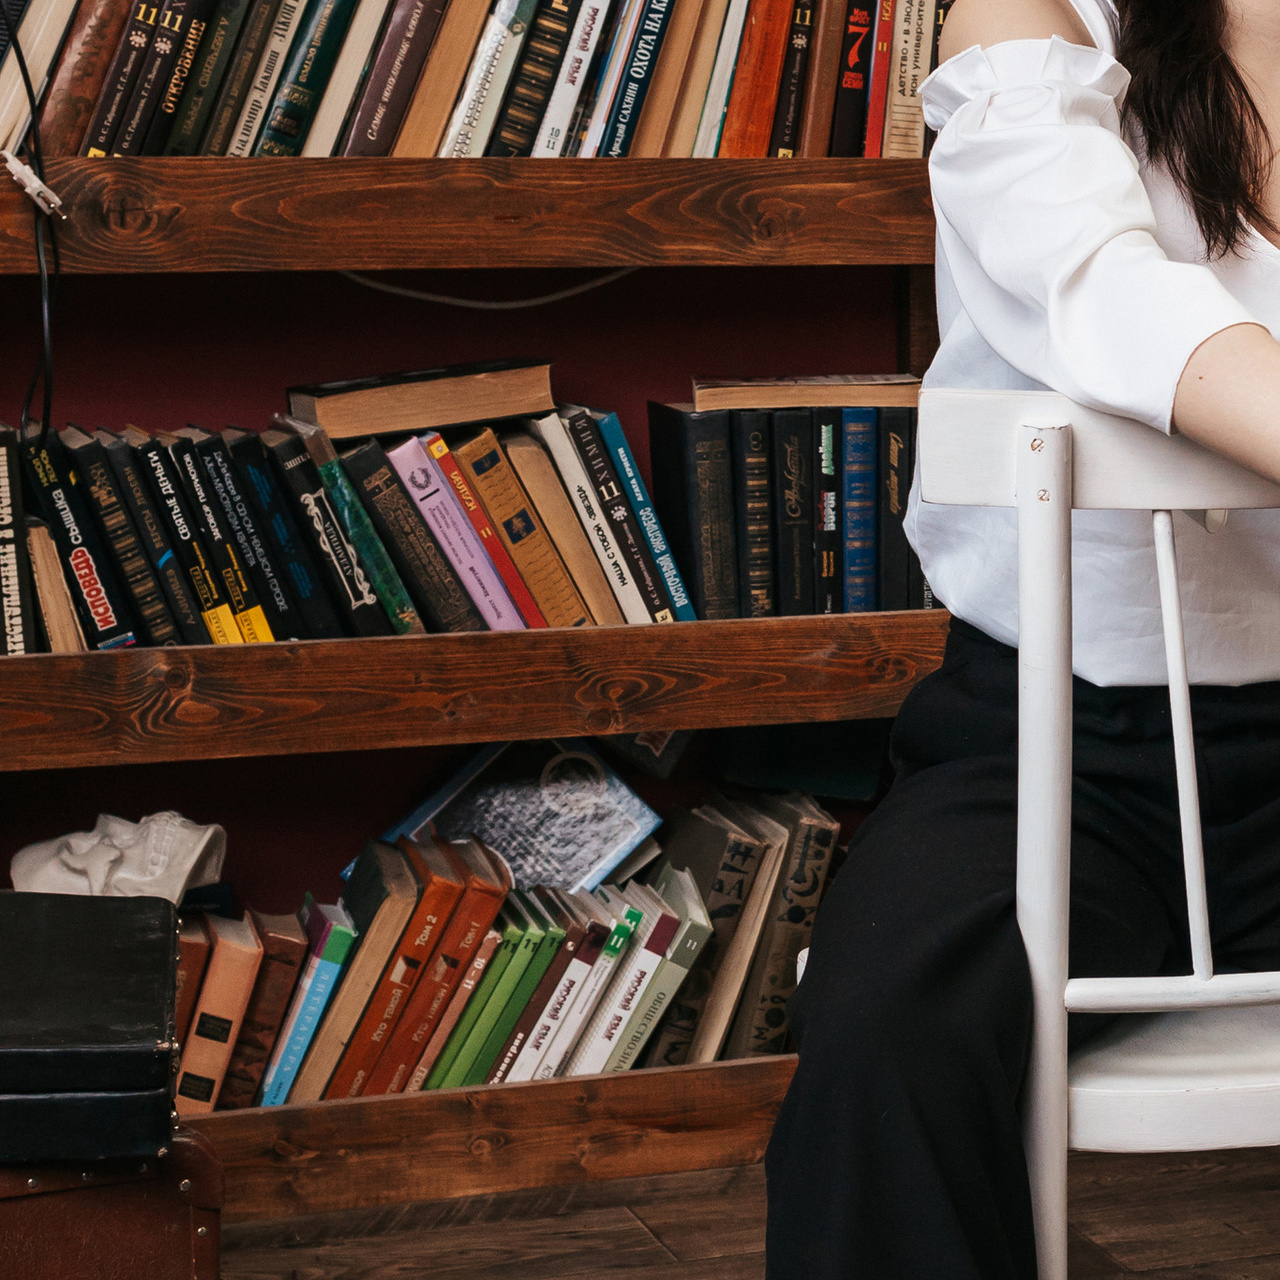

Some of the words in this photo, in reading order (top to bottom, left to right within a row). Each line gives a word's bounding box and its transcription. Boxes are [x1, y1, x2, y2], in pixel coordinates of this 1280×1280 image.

[134, 3, 158, 26] 11
[160, 10, 183, 32] 11
[574, 5, 602, 52] РУССКИЙ
[643, 10, 663, 33] НА
[160, 17, 205, 114] ОТКРОВЕНИЕ
[198, 26, 226, 89] АВЕРЧЕНКО
[629, 31, 657, 80] ОХОТА
[847, 24, 870, 68] 7
[562, 54, 583, 86] ЯЗЫК
[617, 81, 640, 123] САХНИН
[608, 122, 628, 158] Аркадий
[574, 417, 610, 481] ХИМИЯ
[616, 446, 634, 477] КРИСТИ
[122, 466, 145, 507] ЛЮБВИ
[146, 449, 174, 496] ДЕНЬГИ
[181, 452, 207, 502] ПАТРИОТОВ
[448, 470, 476, 513] DEUTSCH
[598, 479, 620, 505] 11
[628, 477, 644, 503] АГАТА
[140, 508, 164, 550] ВЕРСТЫ
[166, 495, 192, 540] СВЯТЫЕ
[200, 502, 223, 541] ЗАГОВОР
[592, 522, 612, 552] ТОБОЙ
[638, 505, 666, 553] ЭКСПРЕСС
[234, 501, 254, 534] ОДНОМ
[249, 534, 273, 578] НЕМЕЦКОМ
[267, 577, 288, 612] ГОРОДКЕ
[606, 551, 615, 560] С
[610, 559, 629, 587] НАША
[68, 545, 115, 631] ИСПОВЕДЬ
[656, 553, 689, 608] ВОСТОЧНЫЙ
[414, 923, 435, 949] Том
[425, 911, 439, 925] 2
[459, 925, 477, 951] Том
[545, 975, 576, 1021] РУССКИЙ
[616, 967, 648, 1013] РУССКИЙ
[280, 971, 331, 1074] ЛИТЕРАТУРА
[371, 1019, 389, 1043] Кто
[381, 985, 405, 1020] такой
[599, 1011, 623, 1043] ЯЗЫК
[528, 1022, 551, 1053] ЯЗЫК
